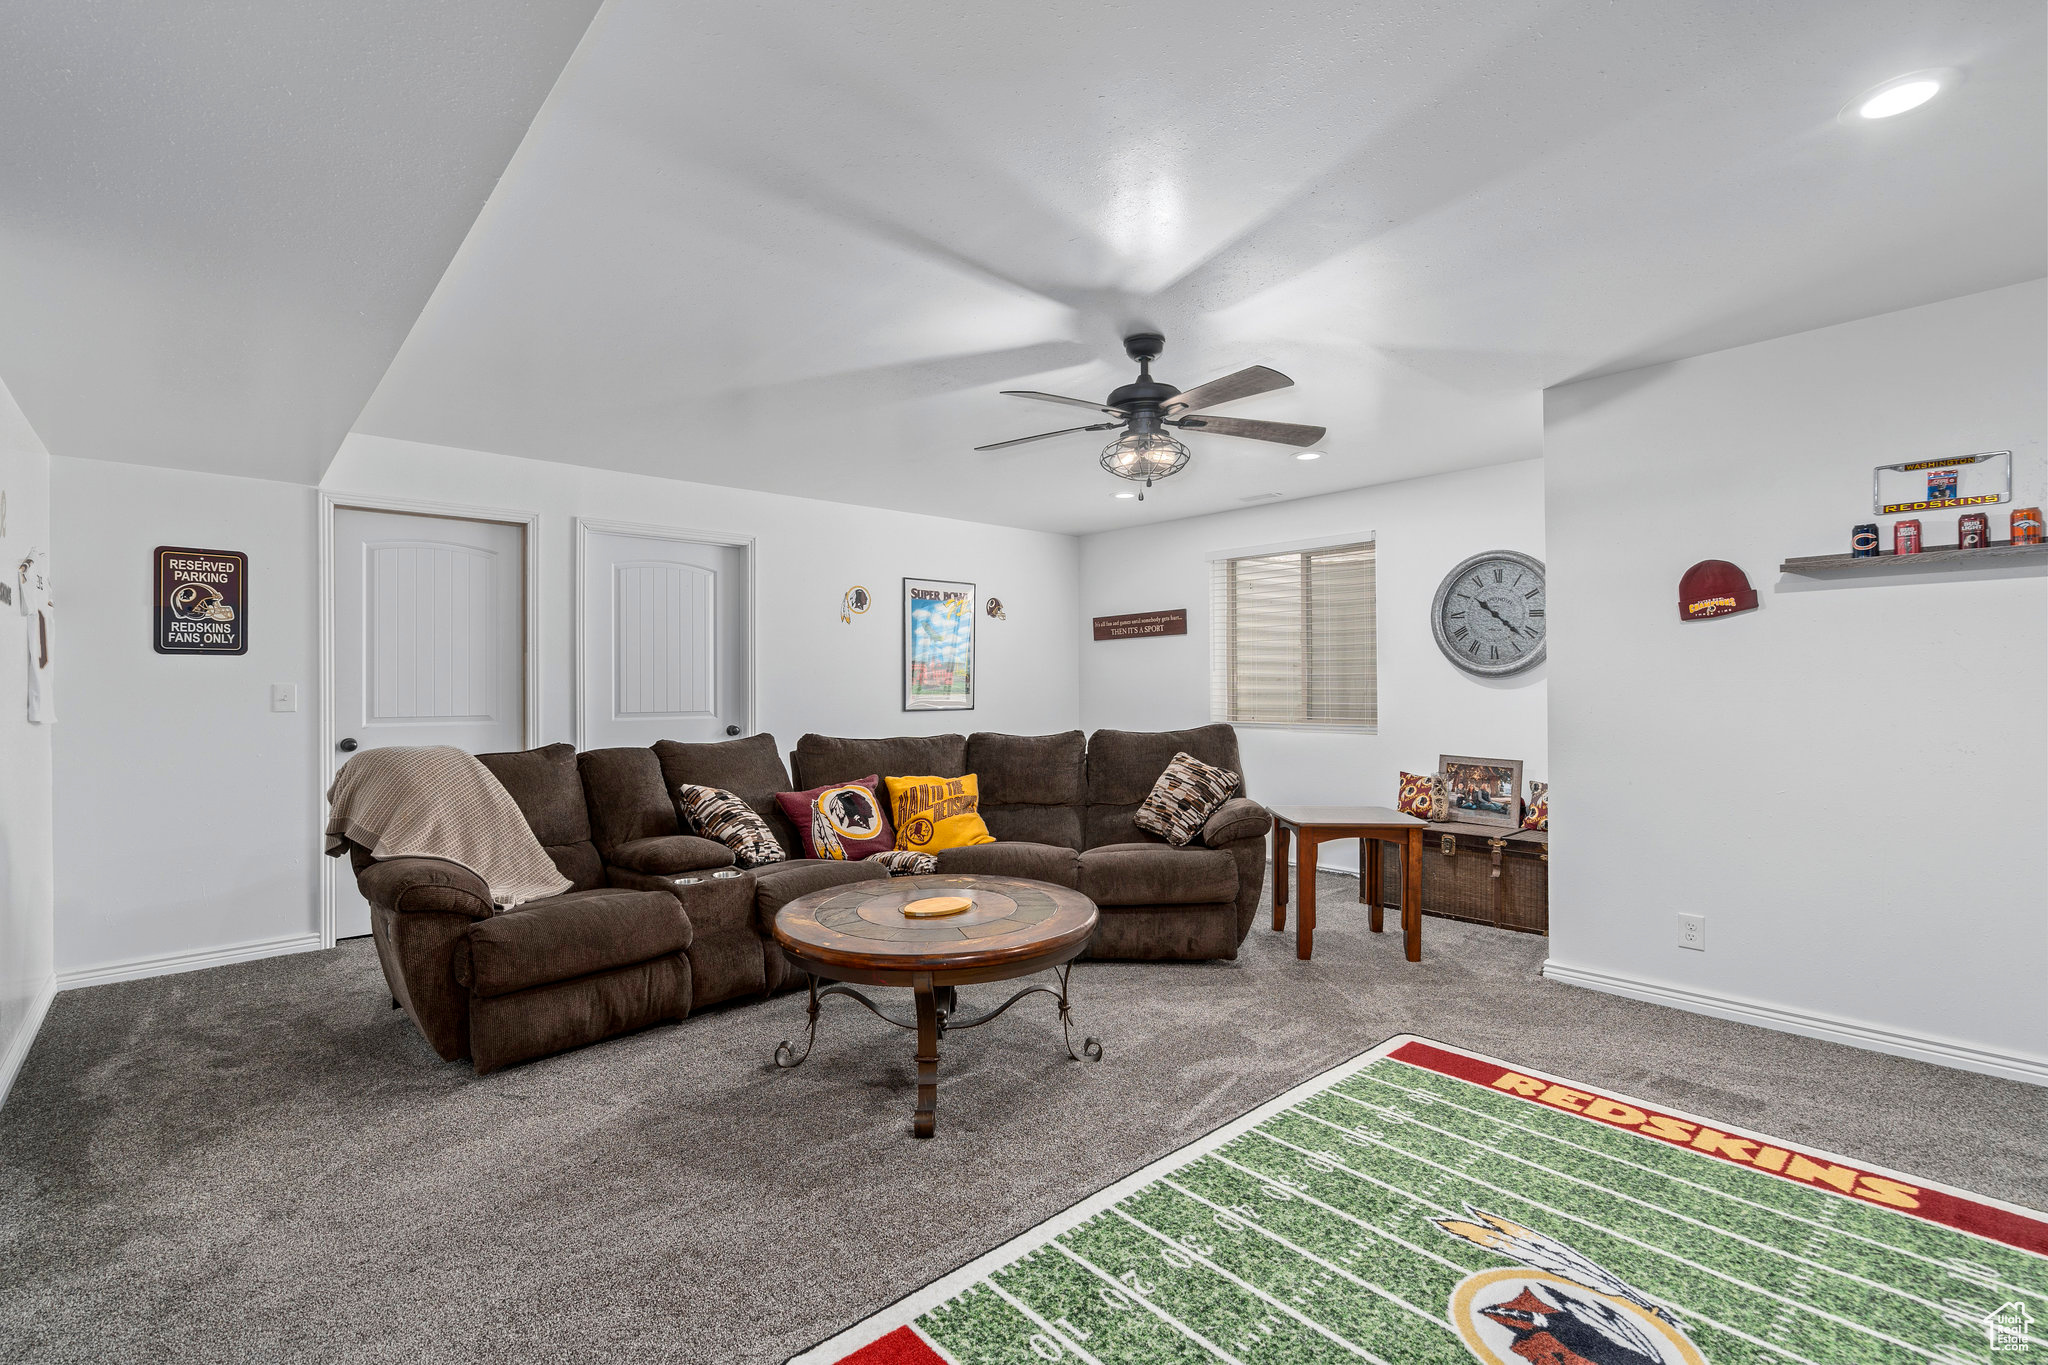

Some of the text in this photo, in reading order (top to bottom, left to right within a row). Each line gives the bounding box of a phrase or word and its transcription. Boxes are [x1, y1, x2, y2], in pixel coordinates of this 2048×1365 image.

[1906, 457, 1975, 470] WASHINGTON
[1885, 494, 1999, 513] REDSKINS
[170, 559, 234, 573] RESERVED
[174, 571, 228, 583] PARKING
[911, 588, 940, 600] SUPER
[171, 622, 231, 633] REDSKINS
[1111, 628, 1127, 636] THEN
[1144, 624, 1164, 633] SPORT
[168, 632, 235, 643] FANS ONLY
[898, 780, 964, 828] HAIL TO THE
[1491, 1071, 1921, 1210] REDSKINS
